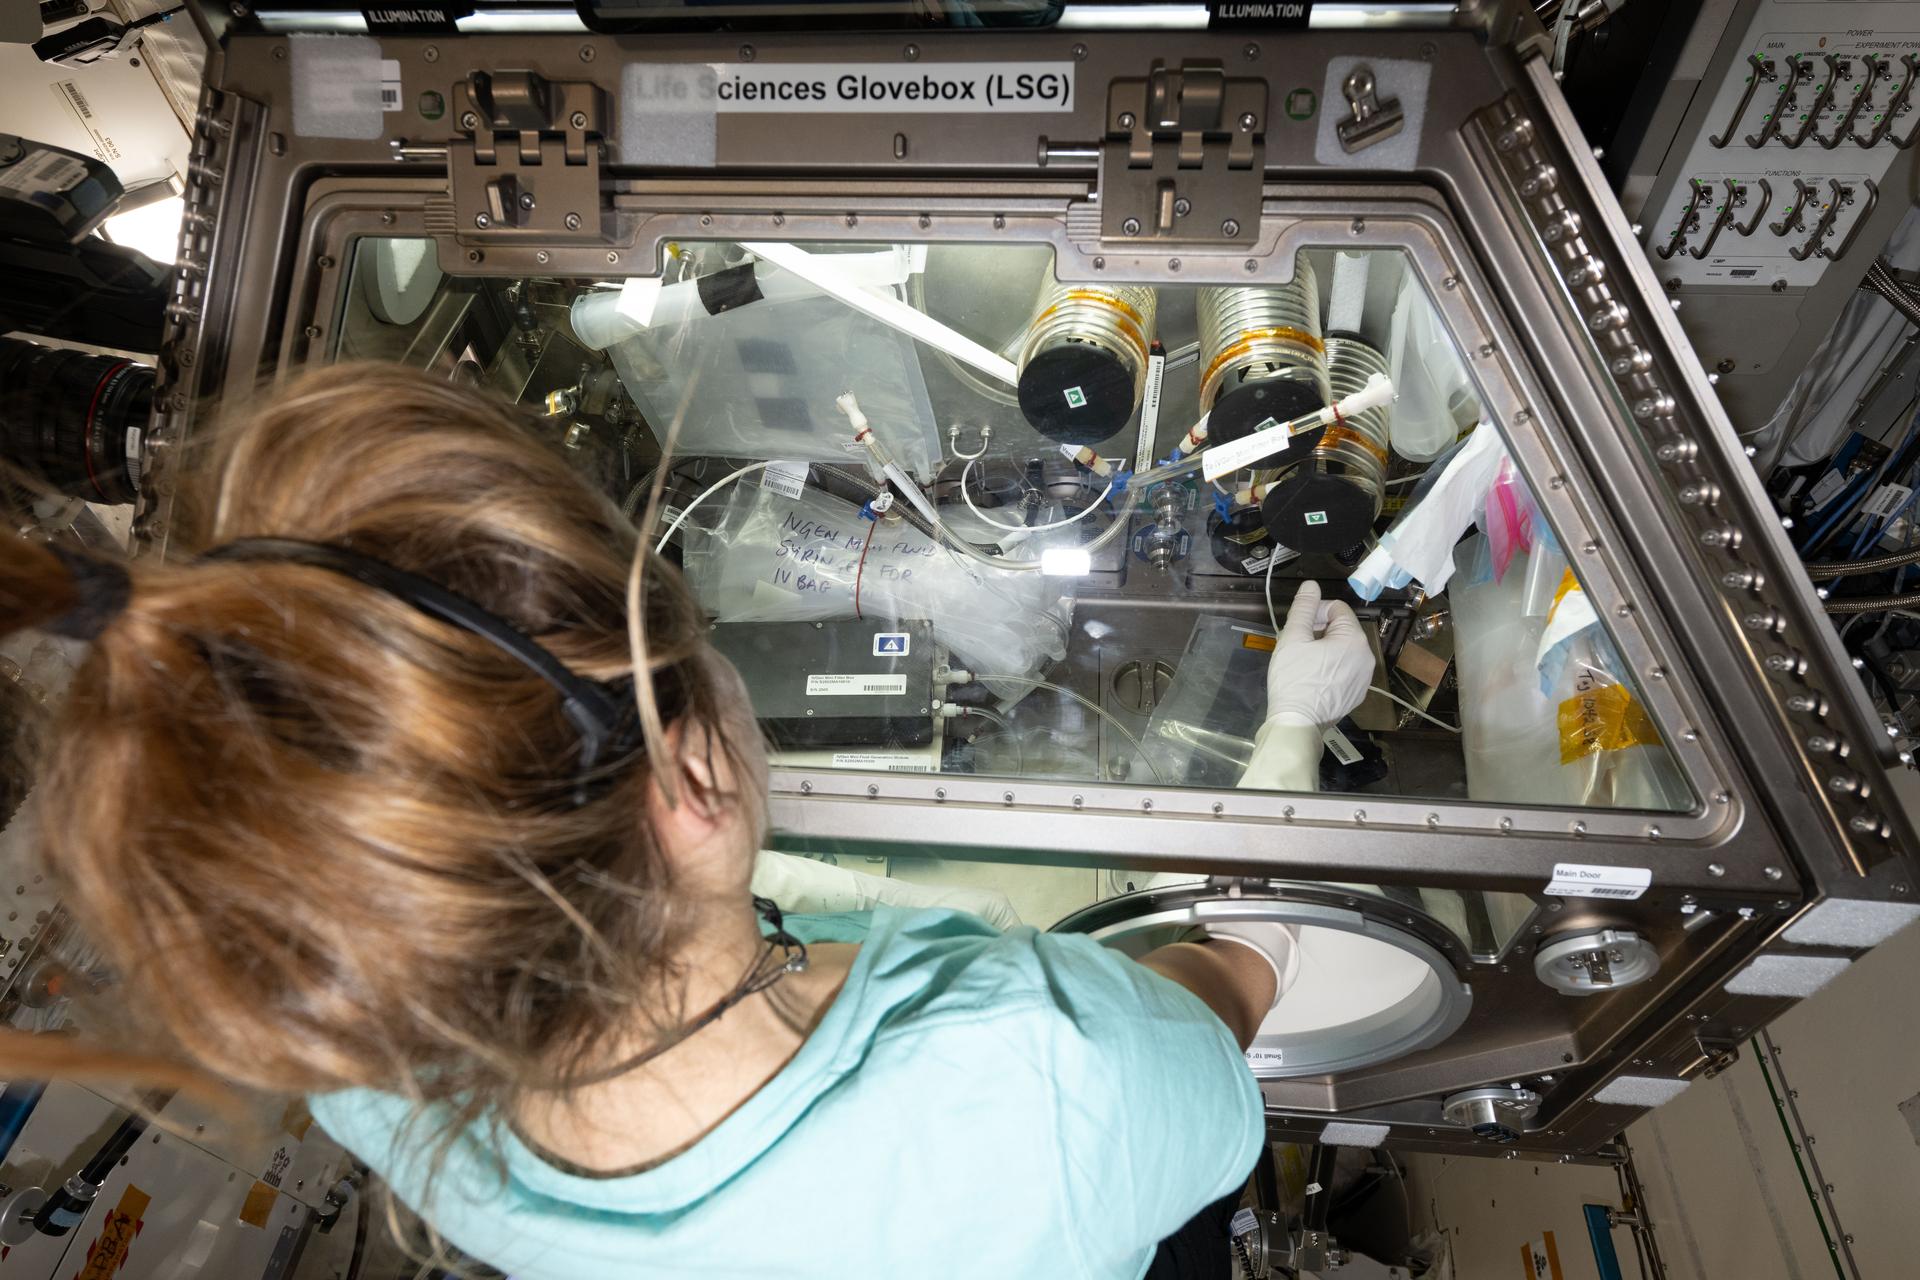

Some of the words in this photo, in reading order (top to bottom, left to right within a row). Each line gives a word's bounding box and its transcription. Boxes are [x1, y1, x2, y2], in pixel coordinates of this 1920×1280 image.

[368, 10, 447, 23] ILLUMINATION
[1219, 4, 1304, 18] ILLUMINATION
[701, 75, 827, 100] Sciences
[836, 74, 976, 100] Glovebox
[985, 73, 1071, 106] (LSG)
[774, 568, 791, 584] IV
[796, 574, 832, 593] BAG
[1556, 869, 1577, 877] Main
[1580, 871, 1602, 879] Door
